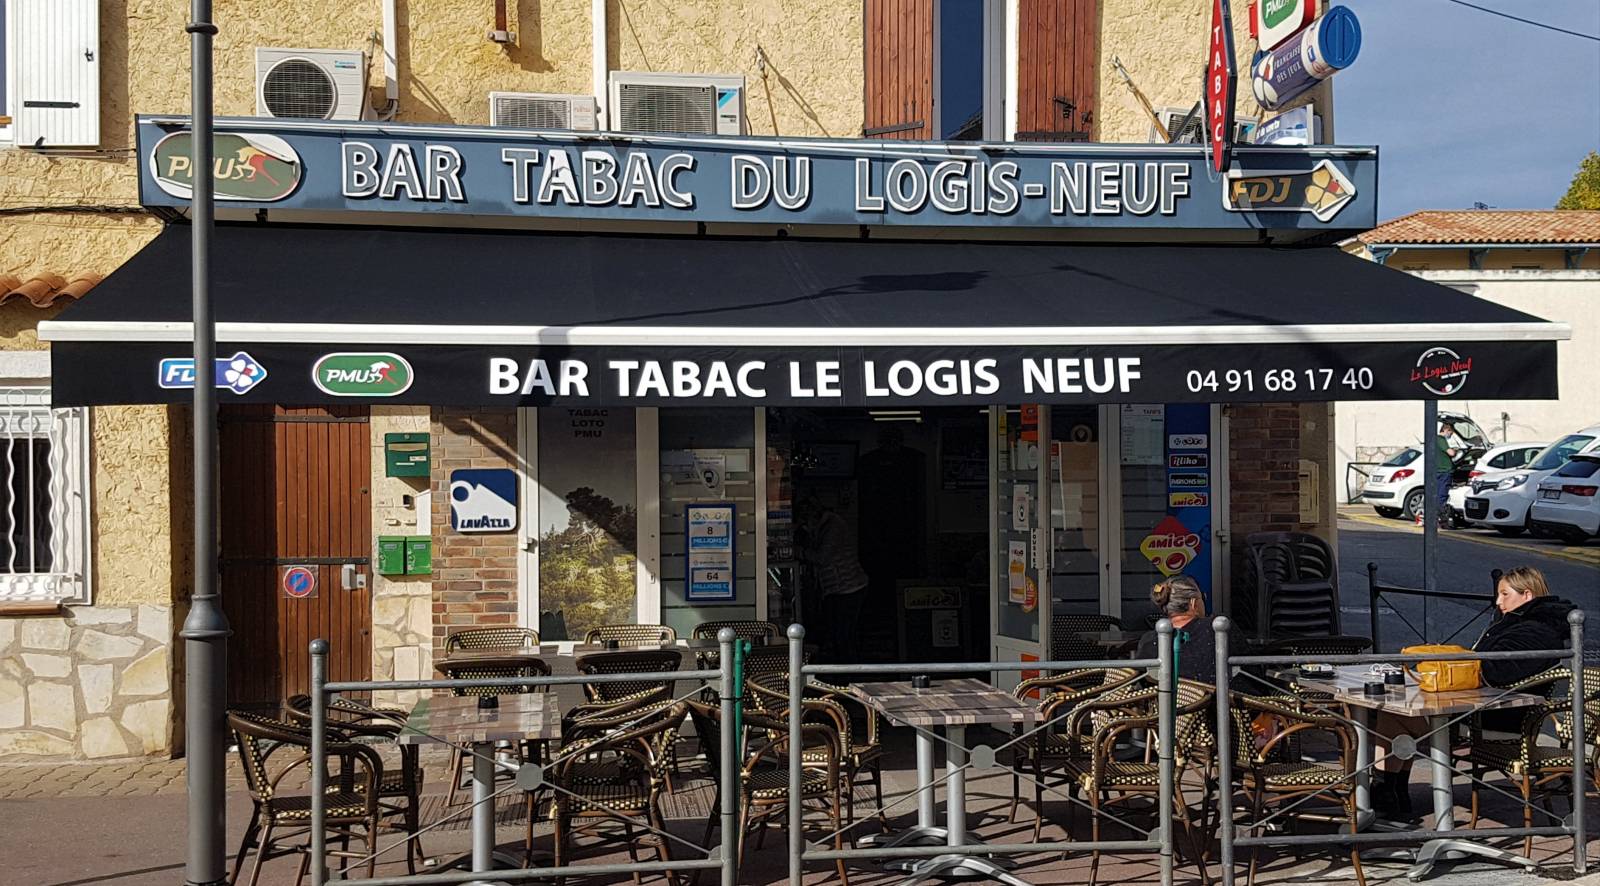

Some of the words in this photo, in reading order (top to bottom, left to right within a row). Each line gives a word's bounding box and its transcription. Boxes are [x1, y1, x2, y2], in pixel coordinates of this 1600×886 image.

[1276, 70, 1288, 83] DES
[1288, 61, 1302, 78] JEUX
[1213, 26, 1222, 142] TABAC
[168, 156, 235, 179] PU
[341, 141, 464, 200] BAR
[503, 148, 694, 207] TABAC
[731, 156, 810, 210] DU
[855, 158, 1190, 214] LOGIS-NEUF
[1231, 177, 1292, 203] FDJ
[166, 364, 195, 383] FD
[325, 369, 370, 383] PMU
[489, 358, 590, 396] BAR
[608, 361, 767, 397] TABAC
[789, 361, 842, 397] LE
[864, 359, 1000, 397] LOGIS
[1022, 358, 1141, 394] NEUF
[1410, 369, 1422, 381] Le
[1424, 366, 1448, 379] Logis
[1451, 357, 1472, 373] Neuf
[1186, 370, 1220, 392] 04
[1225, 369, 1254, 392] 91
[1264, 369, 1297, 391] 68
[1304, 368, 1334, 391] 17
[1342, 367, 1374, 390] 40
[568, 409, 609, 417] TABAC
[572, 419, 605, 428] LOTO
[575, 430, 602, 438] PMU
[460, 515, 511, 529] LAVAZZA
[706, 526, 714, 535] 8
[1148, 532, 1199, 549] AMIGO
[706, 572, 719, 581] 64
